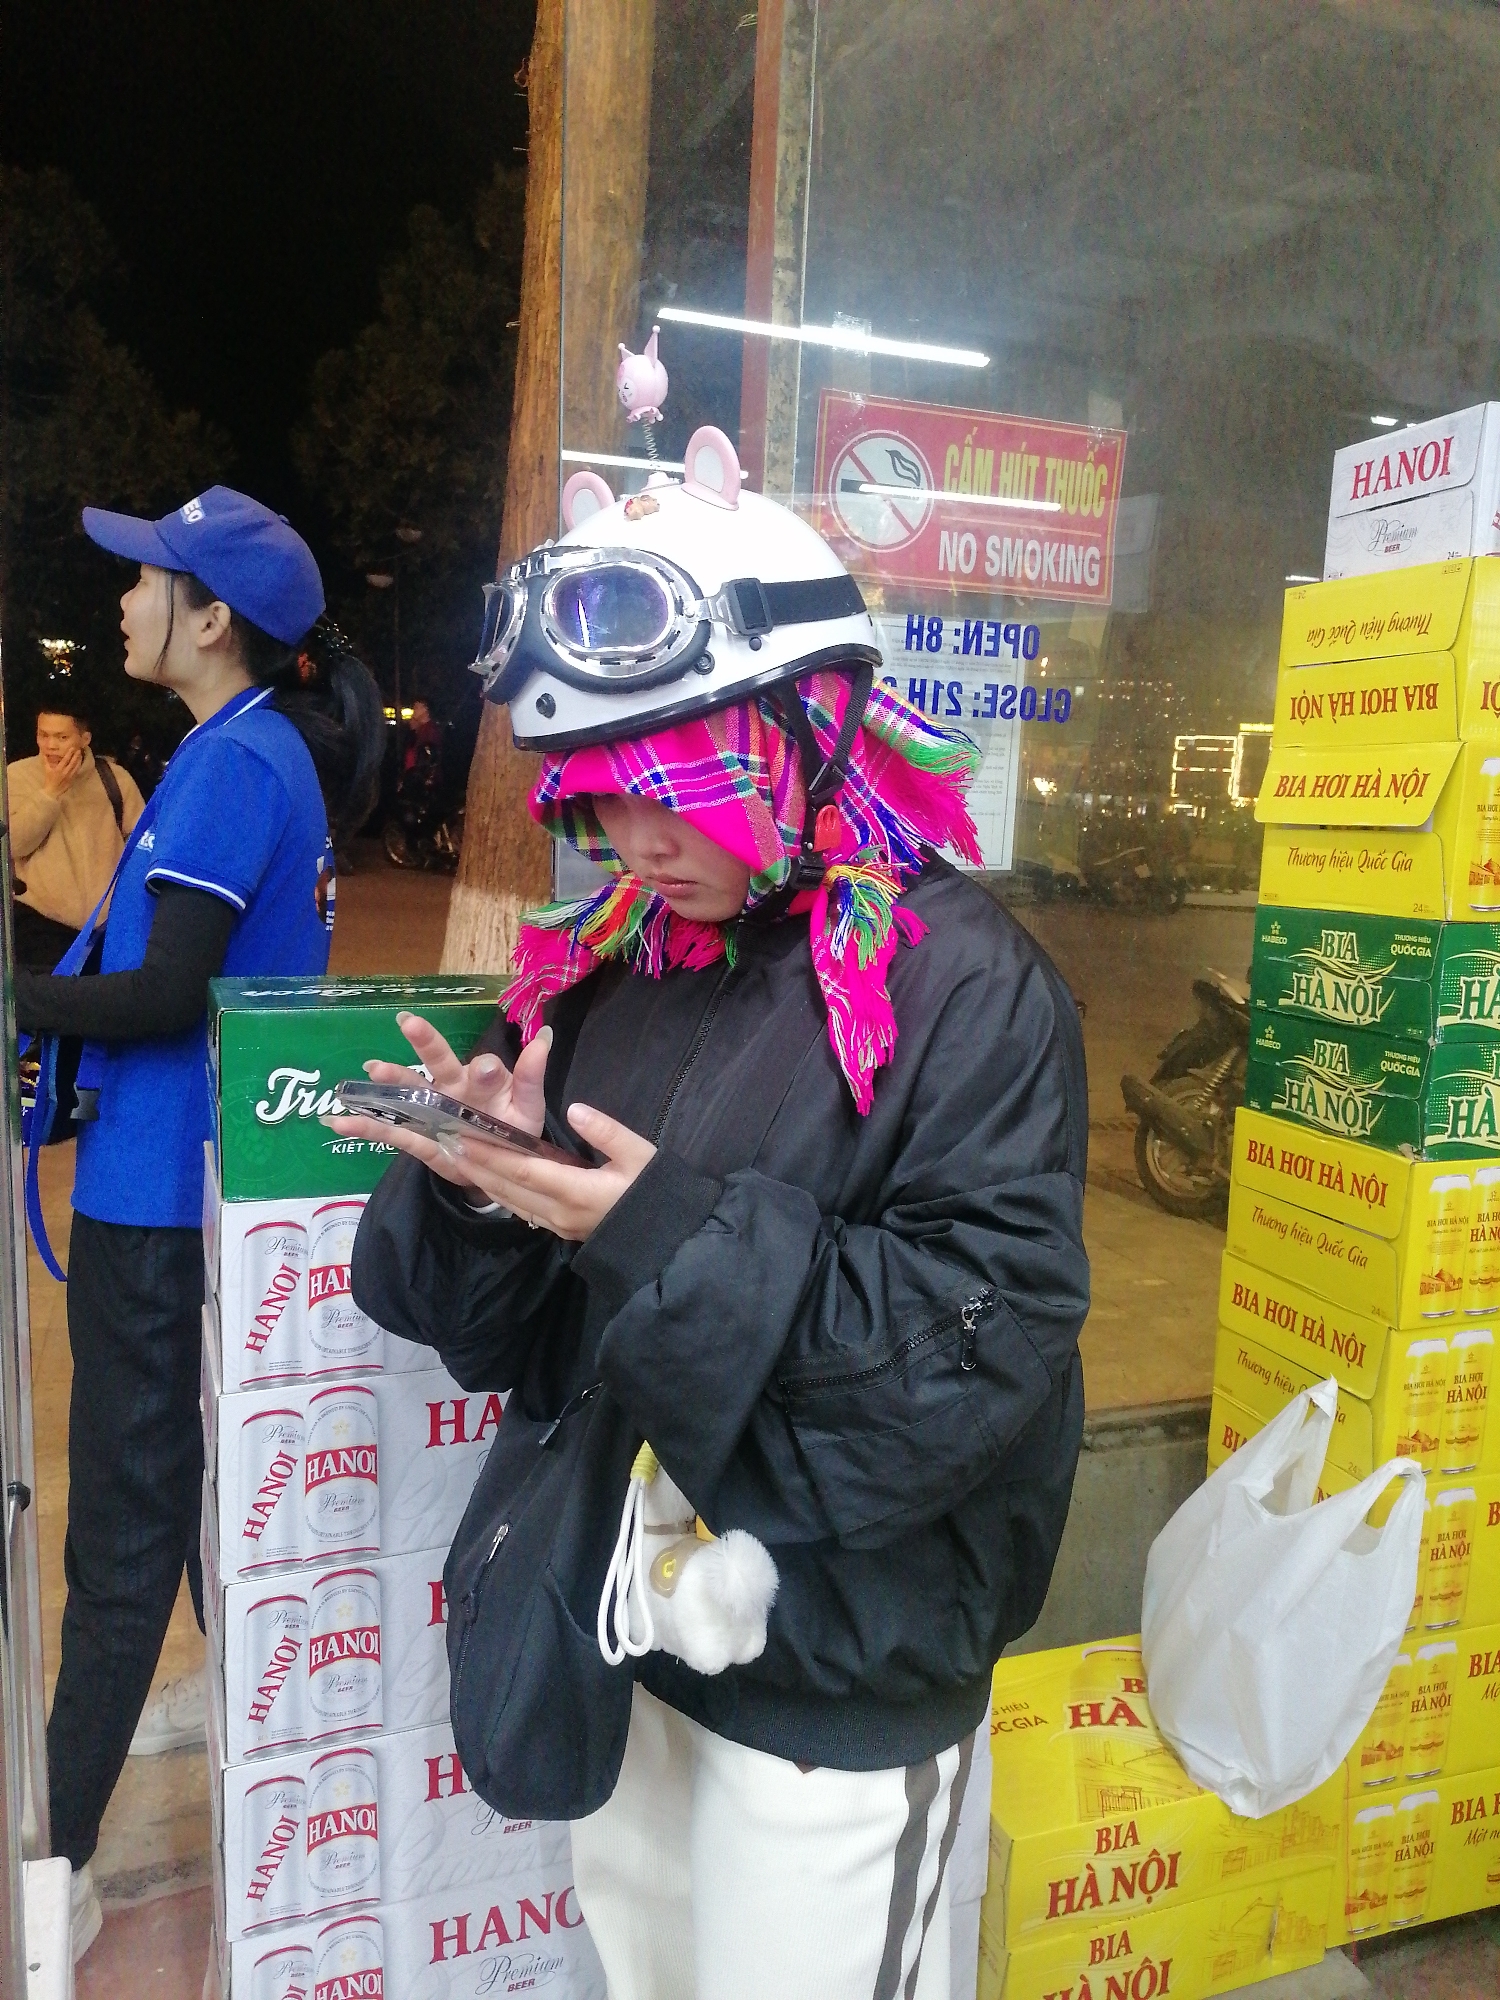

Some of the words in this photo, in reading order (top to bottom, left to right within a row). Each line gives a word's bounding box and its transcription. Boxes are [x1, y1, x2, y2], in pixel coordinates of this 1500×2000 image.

[944, 427, 994, 497] CẤM
[1000, 442, 1040, 502] HÚT
[1045, 444, 1108, 518] THUỐC
[1350, 436, 1455, 500] HANOI
[1368, 519, 1418, 553] Premium
[938, 530, 977, 573] NO
[985, 536, 1100, 587] SMOKING
[1289, 689, 1325, 726] NỘI
[1328, 690, 1356, 724] HÀ
[1403, 682, 1439, 711] BIA
[1273, 774, 1306, 798] BIA
[1309, 773, 1351, 798] HƠI
[1351, 767, 1381, 798] HÀ
[1384, 767, 1431, 805] NỘI
[1287, 846, 1325, 873] Thương
[1329, 848, 1353, 873] hiệu
[1357, 849, 1387, 873] Quốc
[1391, 850, 1413, 872] Gia
[1413, 903, 1423, 913] 24
[1261, 934, 1288, 945] HABECO
[1322, 930, 1358, 964] BIA
[1416, 947, 1432, 958] GIA
[1293, 967, 1328, 1011] HÀ
[1332, 975, 1382, 1025] NỘI
[1314, 1039, 1349, 1075] BIA
[1406, 1065, 1421, 1078] GIA
[1285, 1076, 1320, 1120] HÀ
[1323, 1086, 1372, 1137] NỘI
[1447, 1085, 1499, 1140] HÀ
[331, 1141, 365, 1155] KIỆT
[1246, 1138, 1275, 1170] BIA
[1279, 1149, 1315, 1183] HƠI
[1318, 1160, 1345, 1194] HÀ
[1349, 1172, 1389, 1210] NỘI
[1252, 1205, 1289, 1240] Thương
[1291, 1221, 1313, 1246] hiệu
[1316, 1232, 1344, 1259] Quốc
[1347, 1245, 1369, 1270] Gia
[1470, 1224, 1487, 1243] HÀ
[244, 1262, 302, 1355] HANOI
[1231, 1281, 1259, 1316] BIA
[1263, 1295, 1298, 1333] HƠI
[1300, 1315, 1326, 1349] HÀ
[1330, 1333, 1367, 1369] NỘI
[1238, 1348, 1271, 1385] Thương
[1273, 1371, 1295, 1396] hiệu
[1446, 1385, 1463, 1404] HÀ
[1465, 1383, 1488, 1404] NỘI
[306, 1449, 377, 1485] HANOI
[242, 1450, 299, 1541] HANOI
[1430, 1543, 1447, 1562] HÀ
[1448, 1540, 1471, 1560] NỘI
[310, 1630, 380, 1668] HANOI
[247, 1634, 303, 1725] HANOI
[1067, 1697, 1147, 1729] HÀ
[1410, 1696, 1428, 1713] HÀ
[1429, 1692, 1452, 1712] NỘI
[1012, 1715, 1048, 1730] GIA
[308, 1808, 377, 1846] HANOI
[503, 1820, 533, 1834] BEER
[1450, 1796, 1487, 1826] BIA
[1094, 1820, 1141, 1856] BIA
[1394, 1844, 1412, 1863] HÀ
[1412, 1841, 1435, 1859] NỘI
[246, 1814, 301, 1902] HANOI
[1045, 1863, 1104, 1920] HÀ
[1110, 1848, 1182, 1904] NỘI
[429, 1886, 583, 1965] HANO
[1088, 1929, 1133, 1967] BIA
[316, 1973, 383, 2000] HANOI
[475, 1953, 565, 1996] Premium
[507, 1978, 536, 1992] BEER
